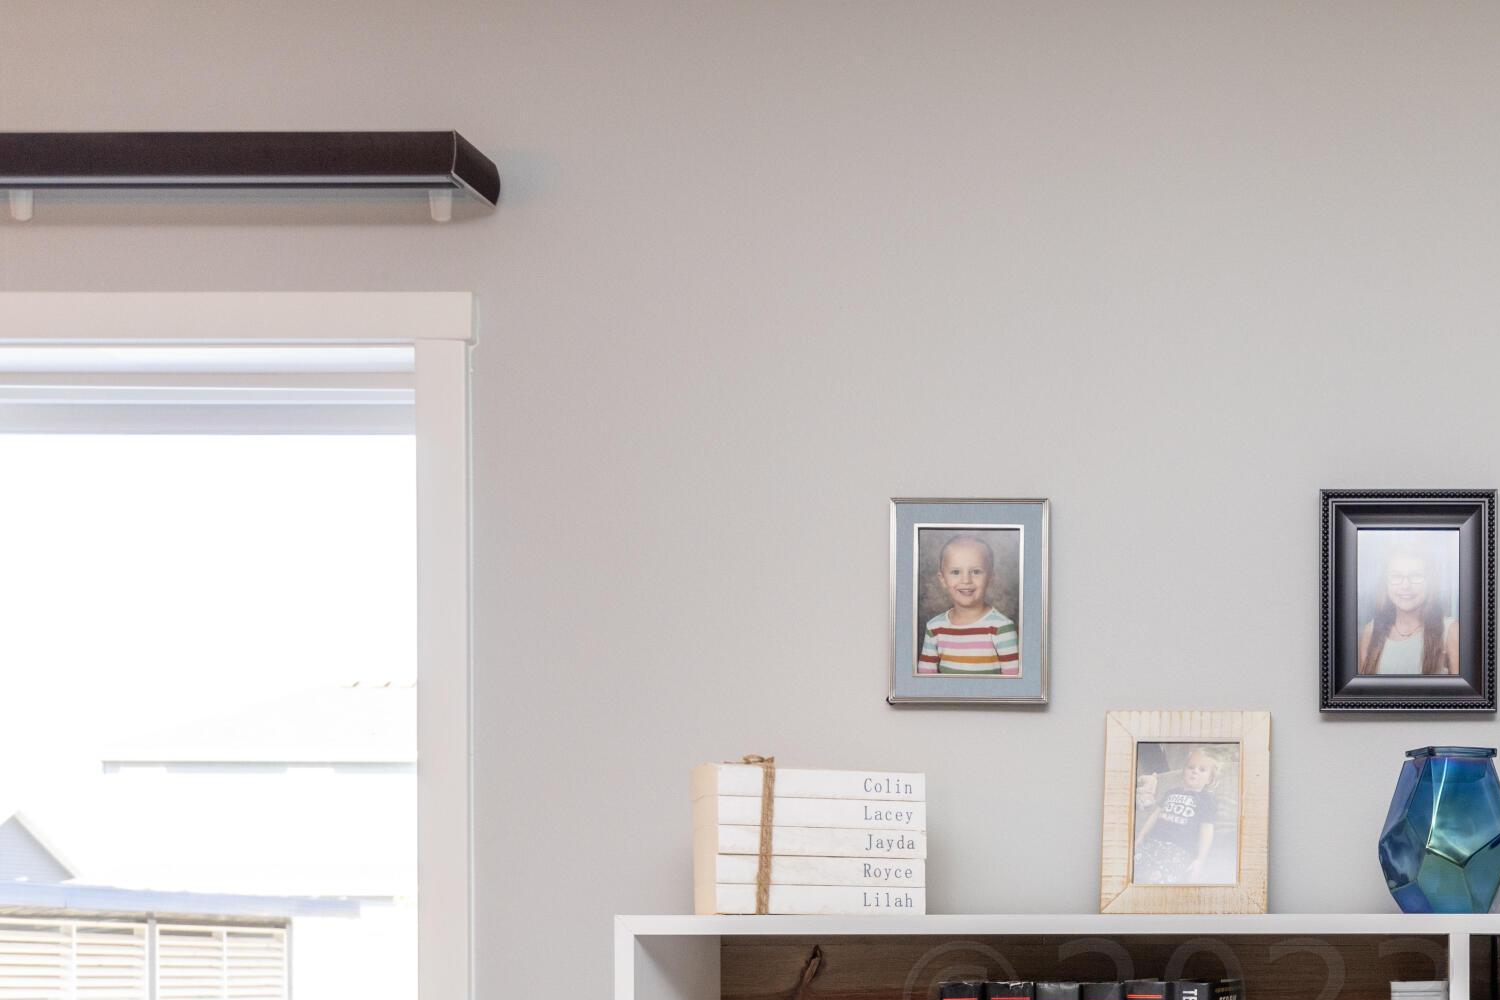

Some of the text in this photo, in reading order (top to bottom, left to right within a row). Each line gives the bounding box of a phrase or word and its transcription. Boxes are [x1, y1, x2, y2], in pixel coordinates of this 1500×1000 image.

[864, 778, 912, 794] Colin
[864, 806, 913, 824] Lacey
[866, 835, 915, 851] Jayda
[863, 864, 913, 880] Royce
[863, 893, 913, 908] Lilah
